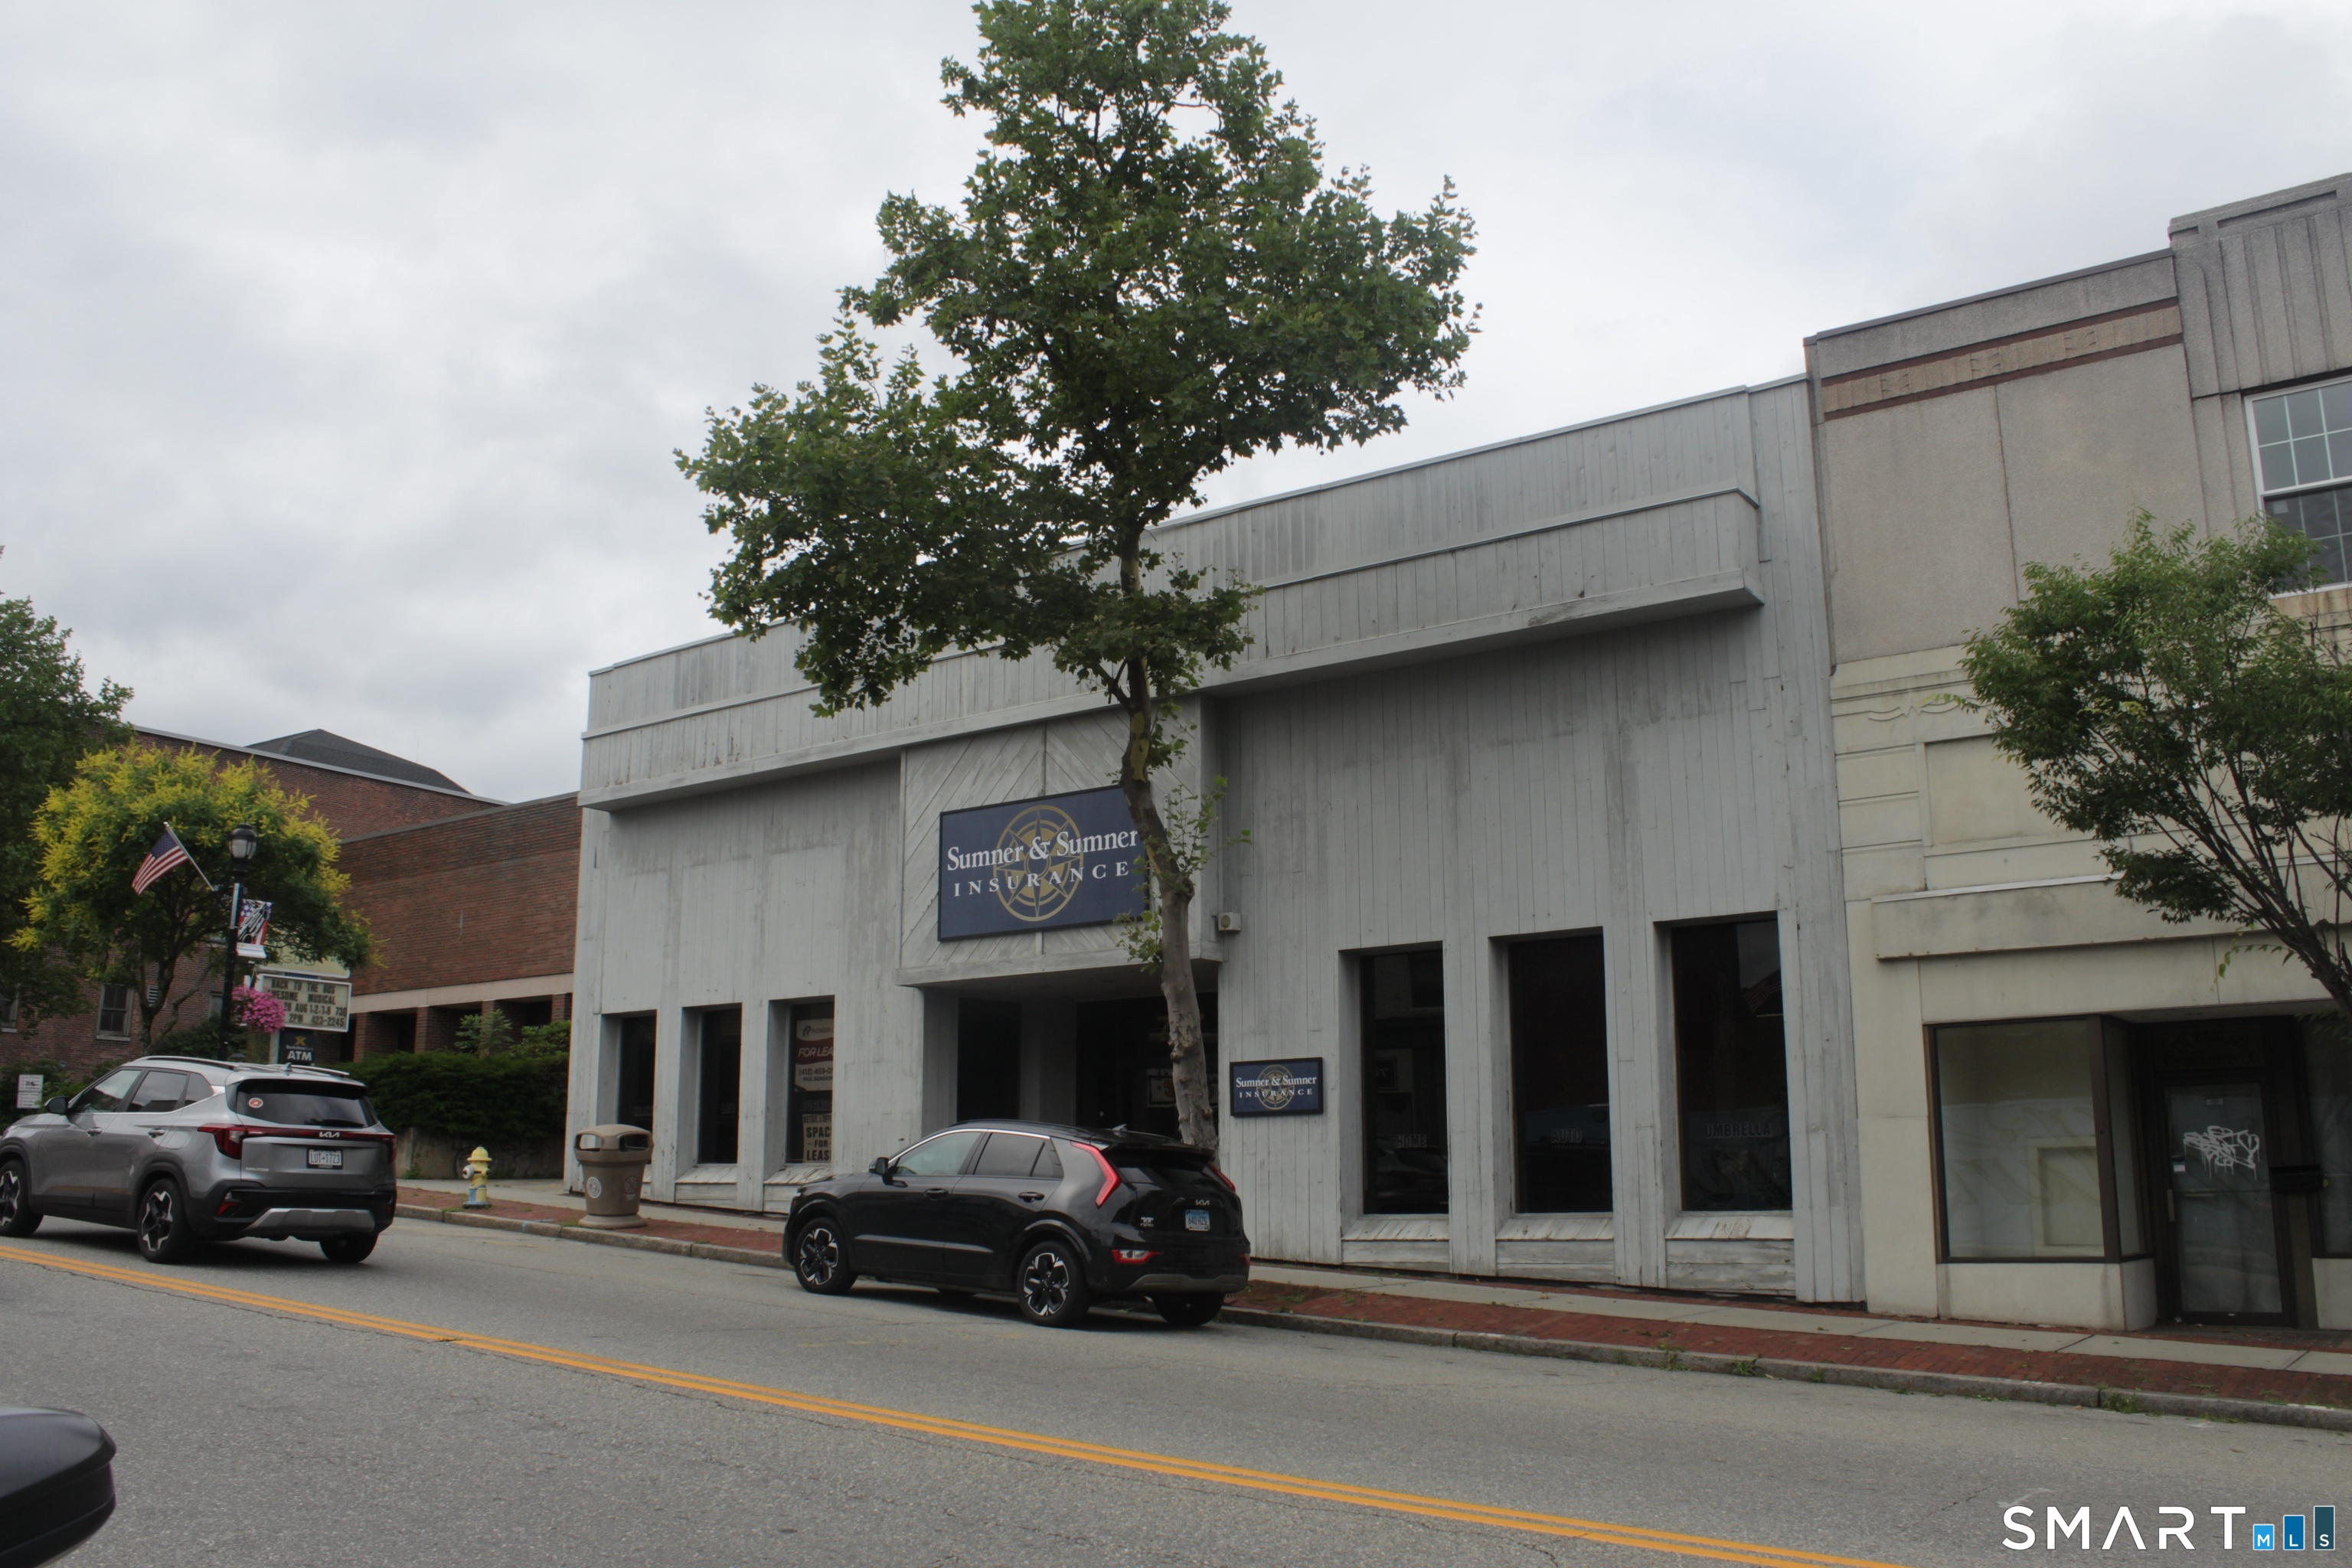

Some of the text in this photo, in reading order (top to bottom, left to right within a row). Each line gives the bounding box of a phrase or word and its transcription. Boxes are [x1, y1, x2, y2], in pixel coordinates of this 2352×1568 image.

[947, 829, 1138, 871] Sumner & Sumner
[954, 861, 1129, 897] INSURANCE
[271, 978, 289, 989] BACK
[294, 981, 302, 991] TO
[307, 982, 318, 993] THE
[308, 994, 336, 1004] MUSICAL
[295, 1004, 308, 1013] AUG
[312, 1015, 345, 1027] 423-2245
[287, 1050, 312, 1061] ATM
[797, 1047, 817, 1058] FOR
[1236, 1074, 1317, 1088] Sumner & Sumner
[1239, 1088, 1313, 1099] INSURANCE
[806, 1126, 831, 1138] SPAC
[1550, 1128, 1583, 1144] AUTO
[1705, 1122, 1773, 1139] UMBRELLA
[814, 1139, 828, 1148] FOR
[1396, 1134, 1427, 1148] HOME
